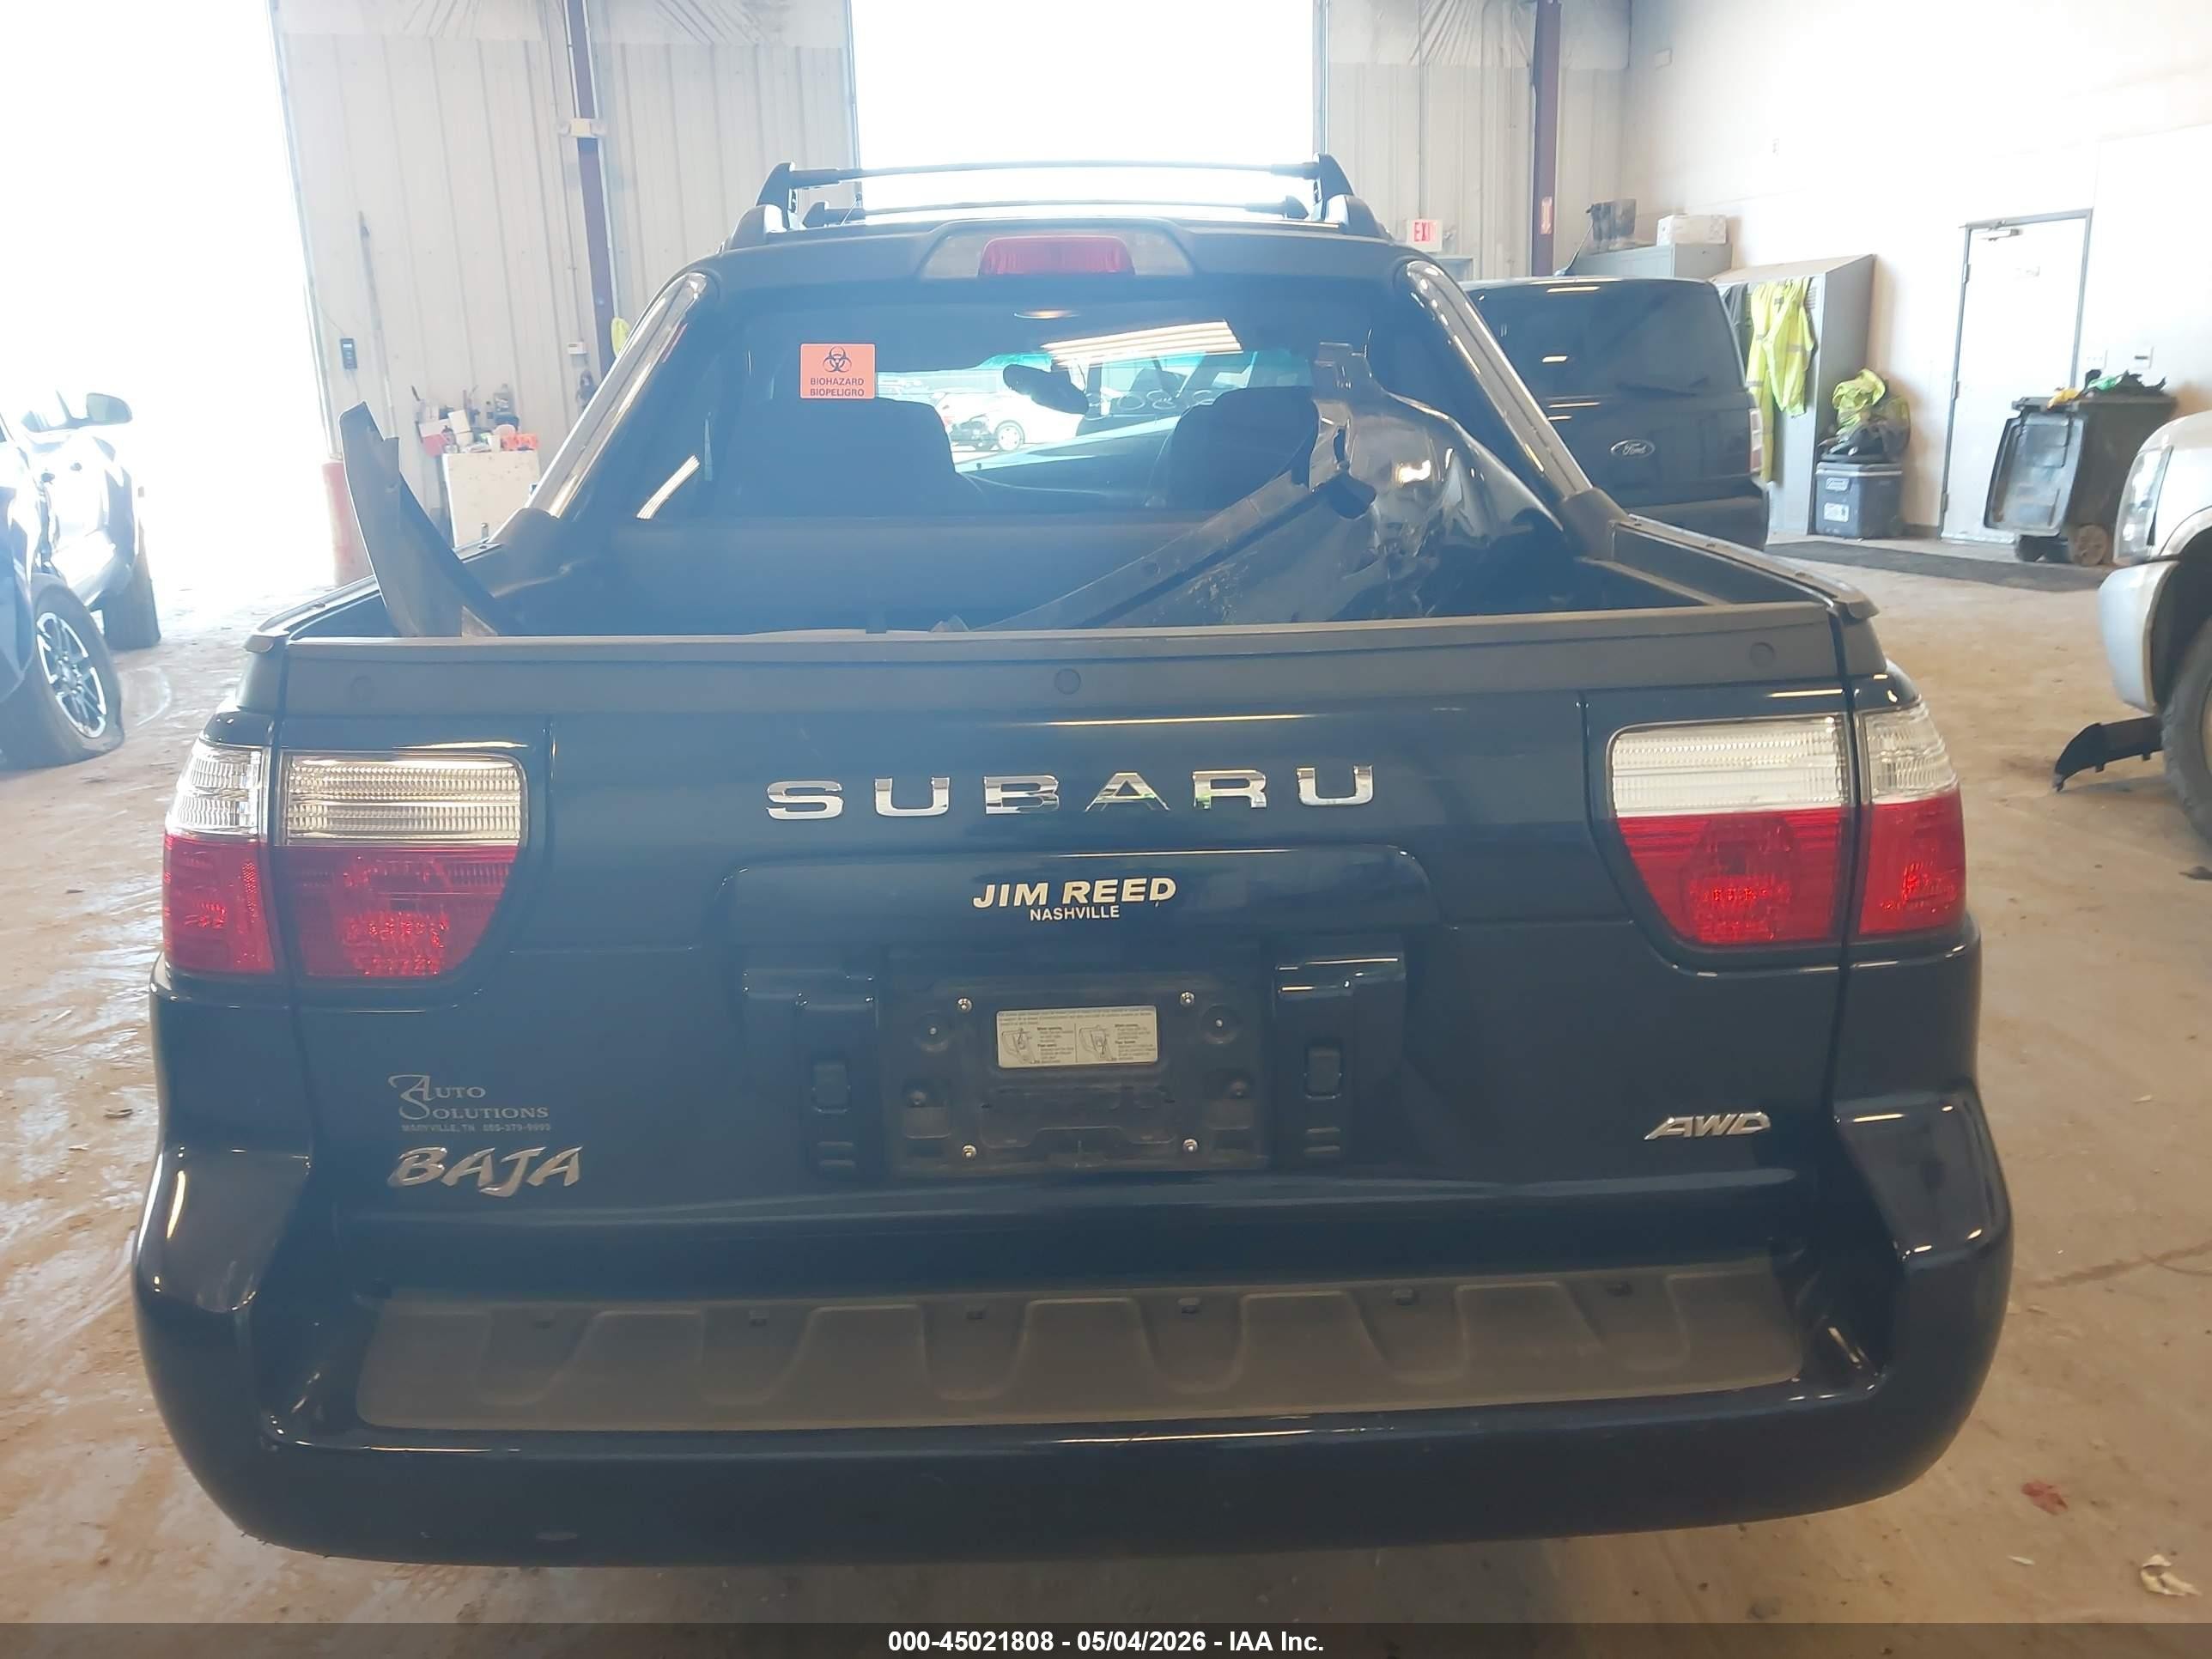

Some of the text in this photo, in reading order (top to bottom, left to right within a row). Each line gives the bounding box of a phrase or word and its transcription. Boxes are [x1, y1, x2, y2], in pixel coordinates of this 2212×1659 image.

[1414, 222, 1436, 242] EXI
[810, 377, 865, 386] BIOHAZARD
[810, 388, 865, 397] BIOPELIGRO
[765, 764, 1374, 821] SUBARU
[972, 877, 1176, 908] JIM REED
[1030, 904, 1121, 921] NASHVILLE
[1644, 1111, 1771, 1140] AWD
[387, 1146, 584, 1198] BAJA
